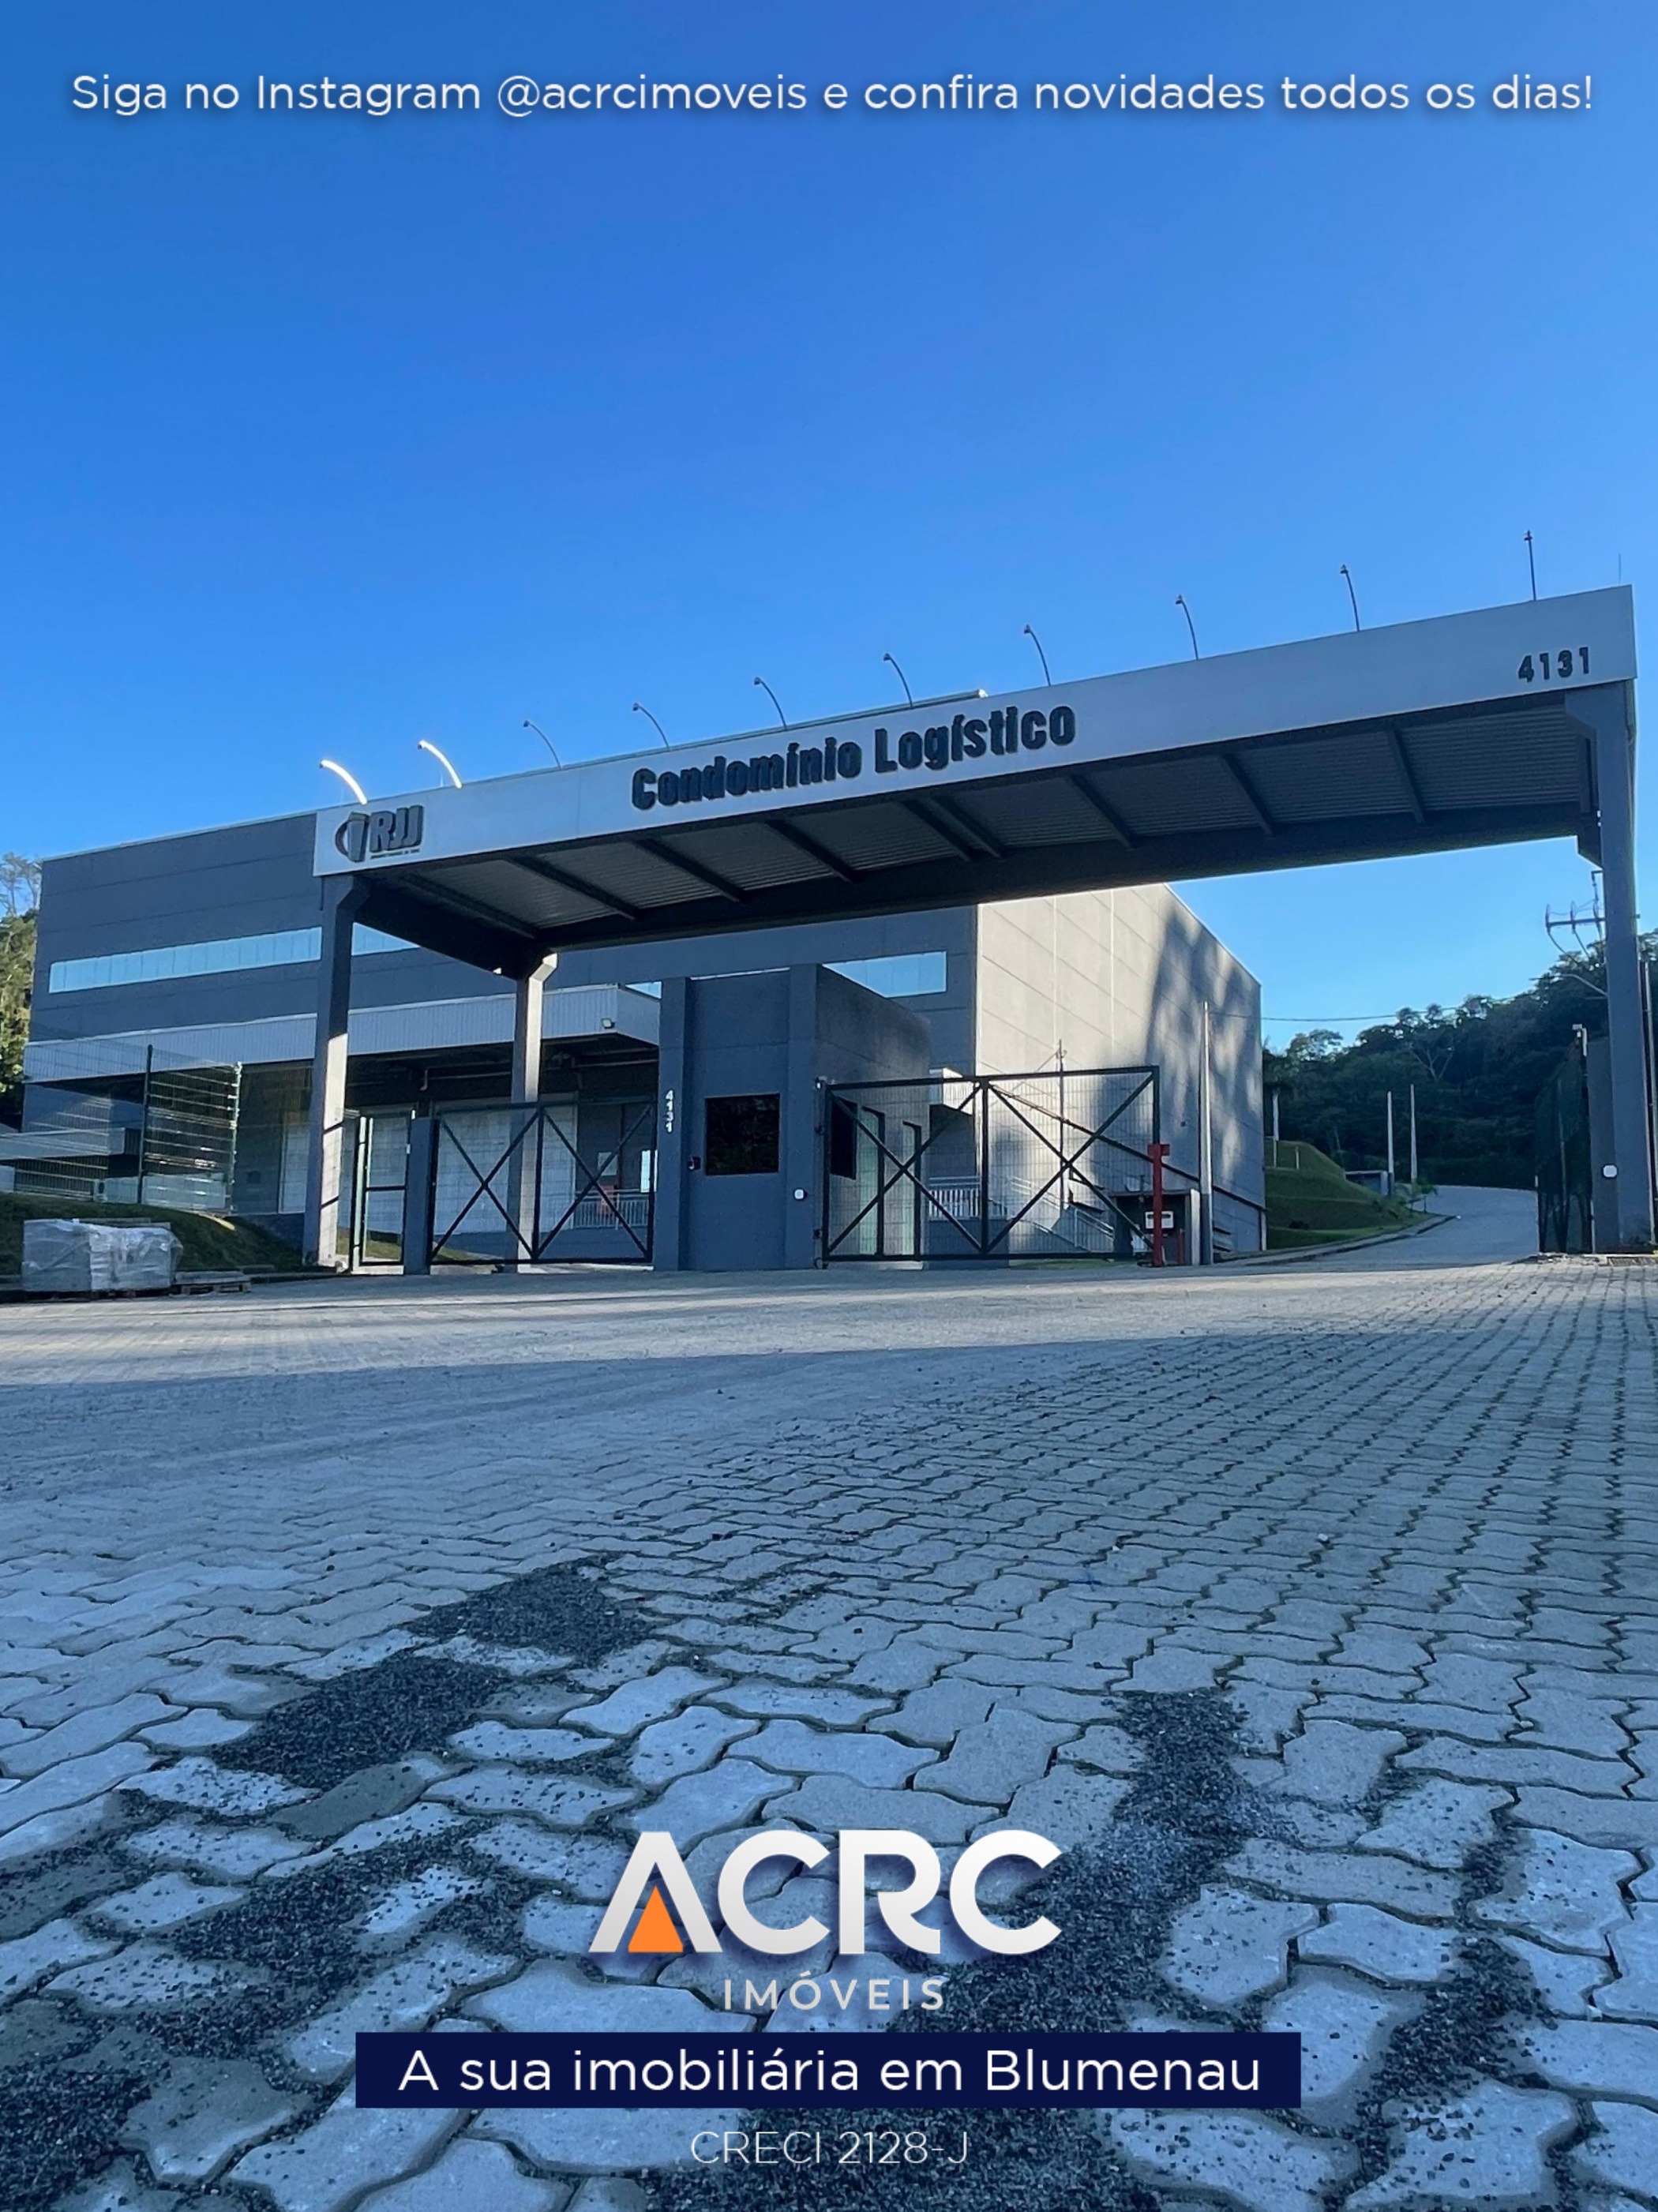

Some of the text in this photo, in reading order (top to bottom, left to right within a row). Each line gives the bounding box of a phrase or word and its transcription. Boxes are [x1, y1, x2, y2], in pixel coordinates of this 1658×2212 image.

[1518, 647, 1589, 683] 4131
[632, 705, 1075, 810] Condomínio Logístico
[665, 1089, 674, 1133] 4131
